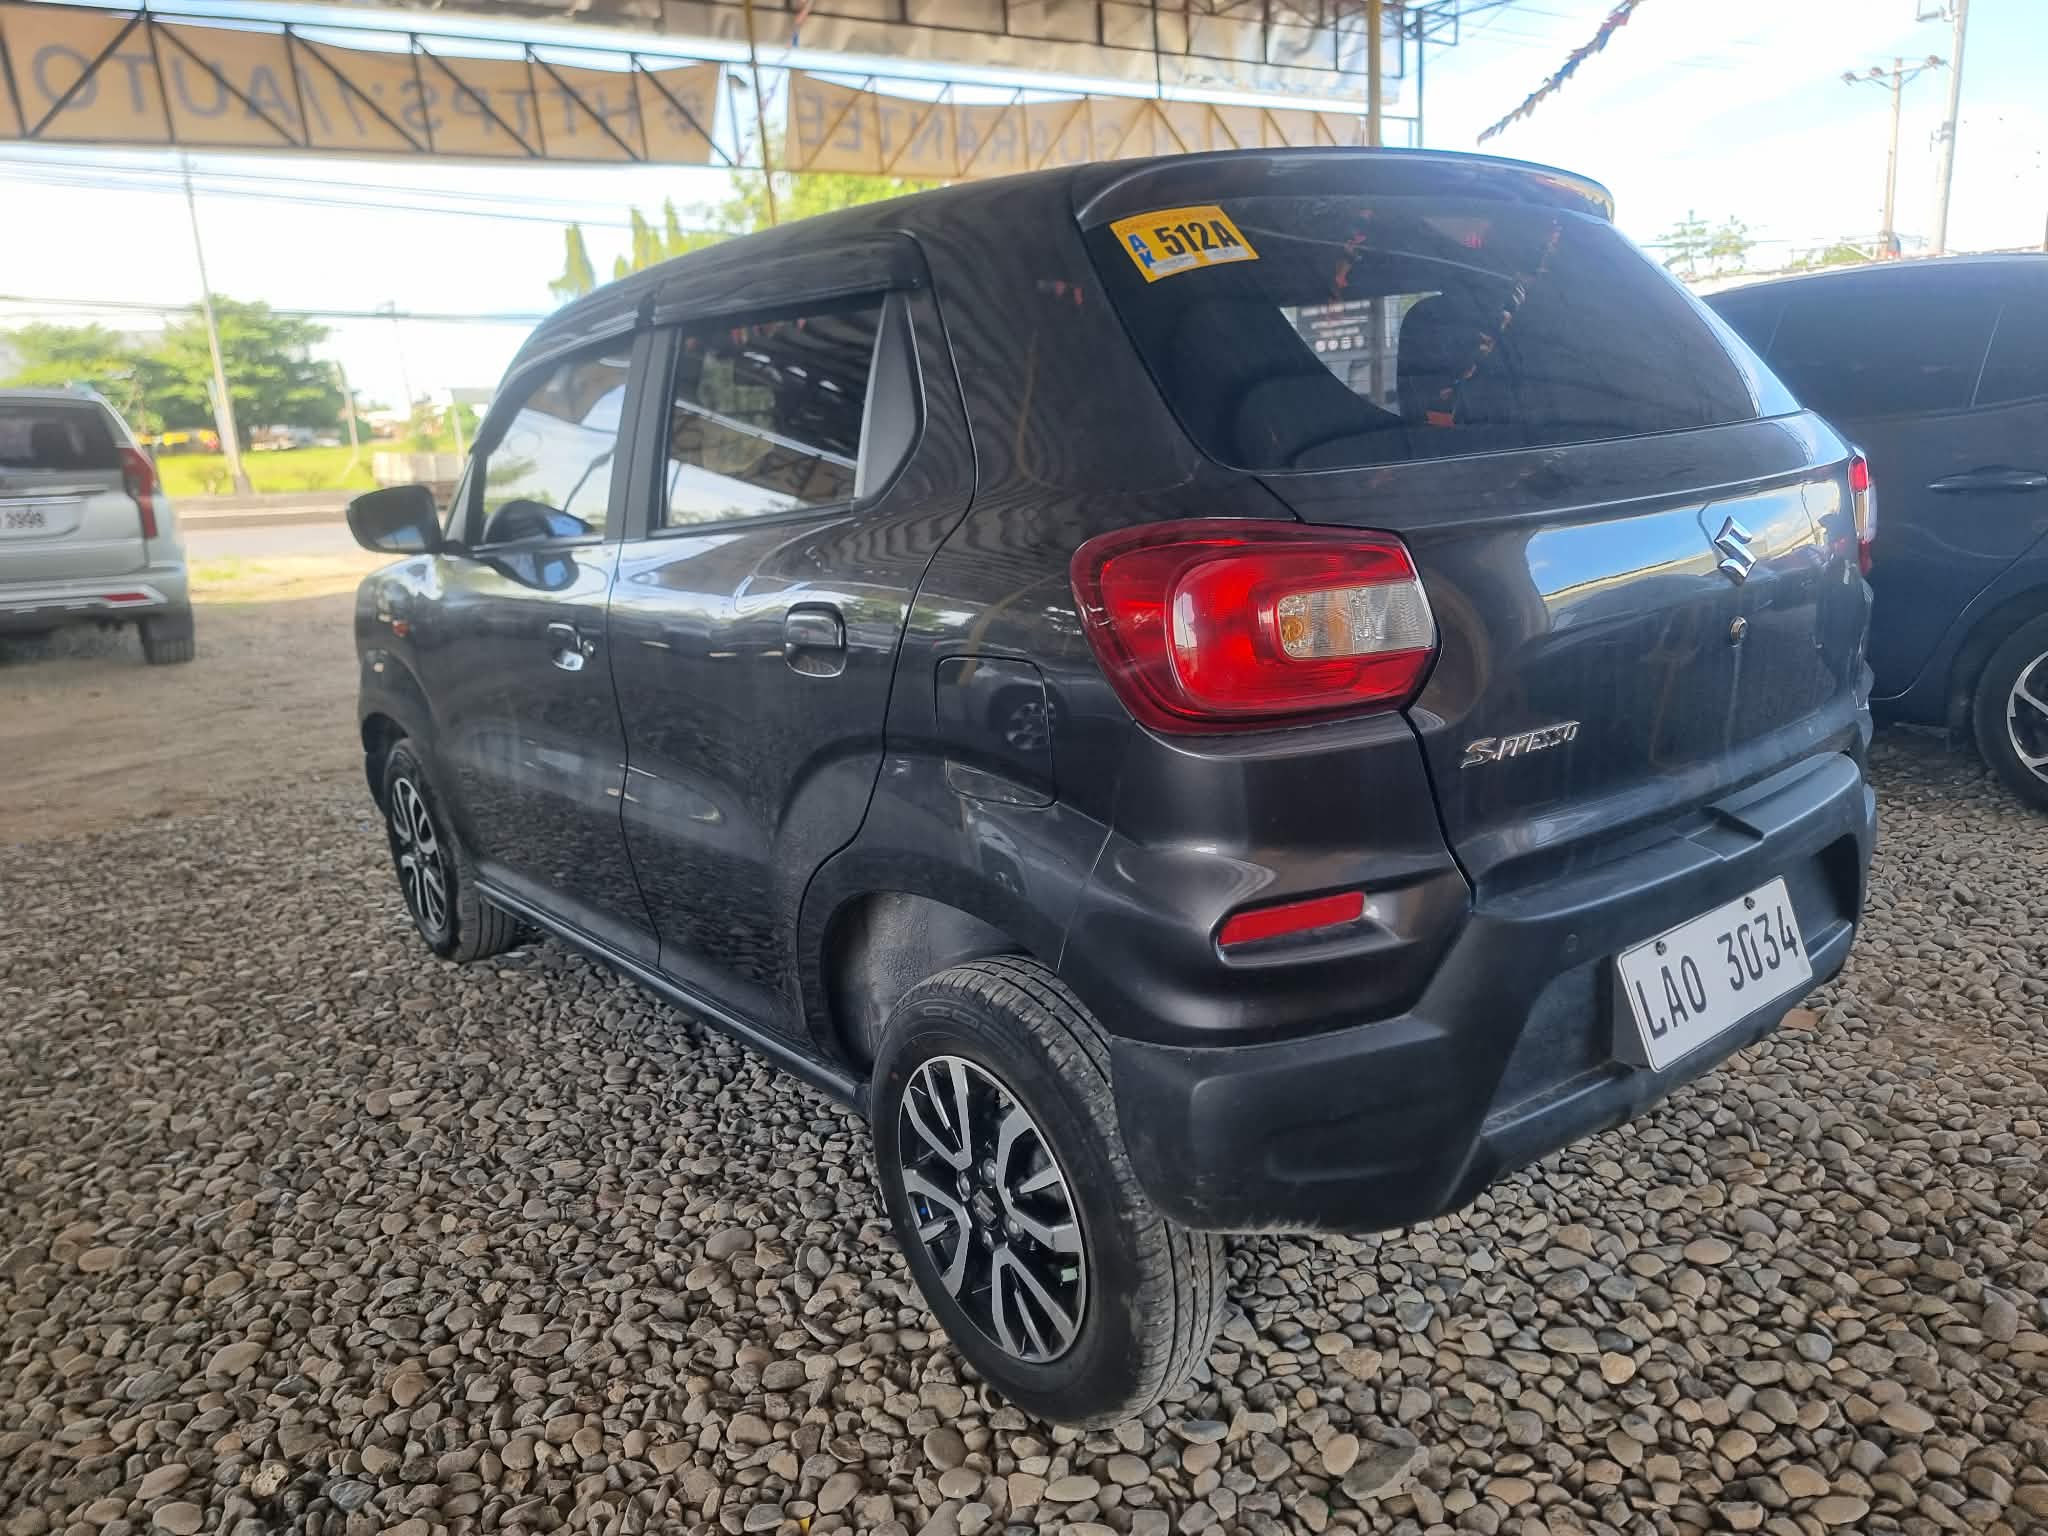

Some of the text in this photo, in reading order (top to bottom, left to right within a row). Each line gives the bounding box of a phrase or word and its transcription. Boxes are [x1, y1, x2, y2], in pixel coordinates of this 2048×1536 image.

[1153, 219, 1242, 257] 512A
[1635, 905, 1799, 1041] LAO 3034
